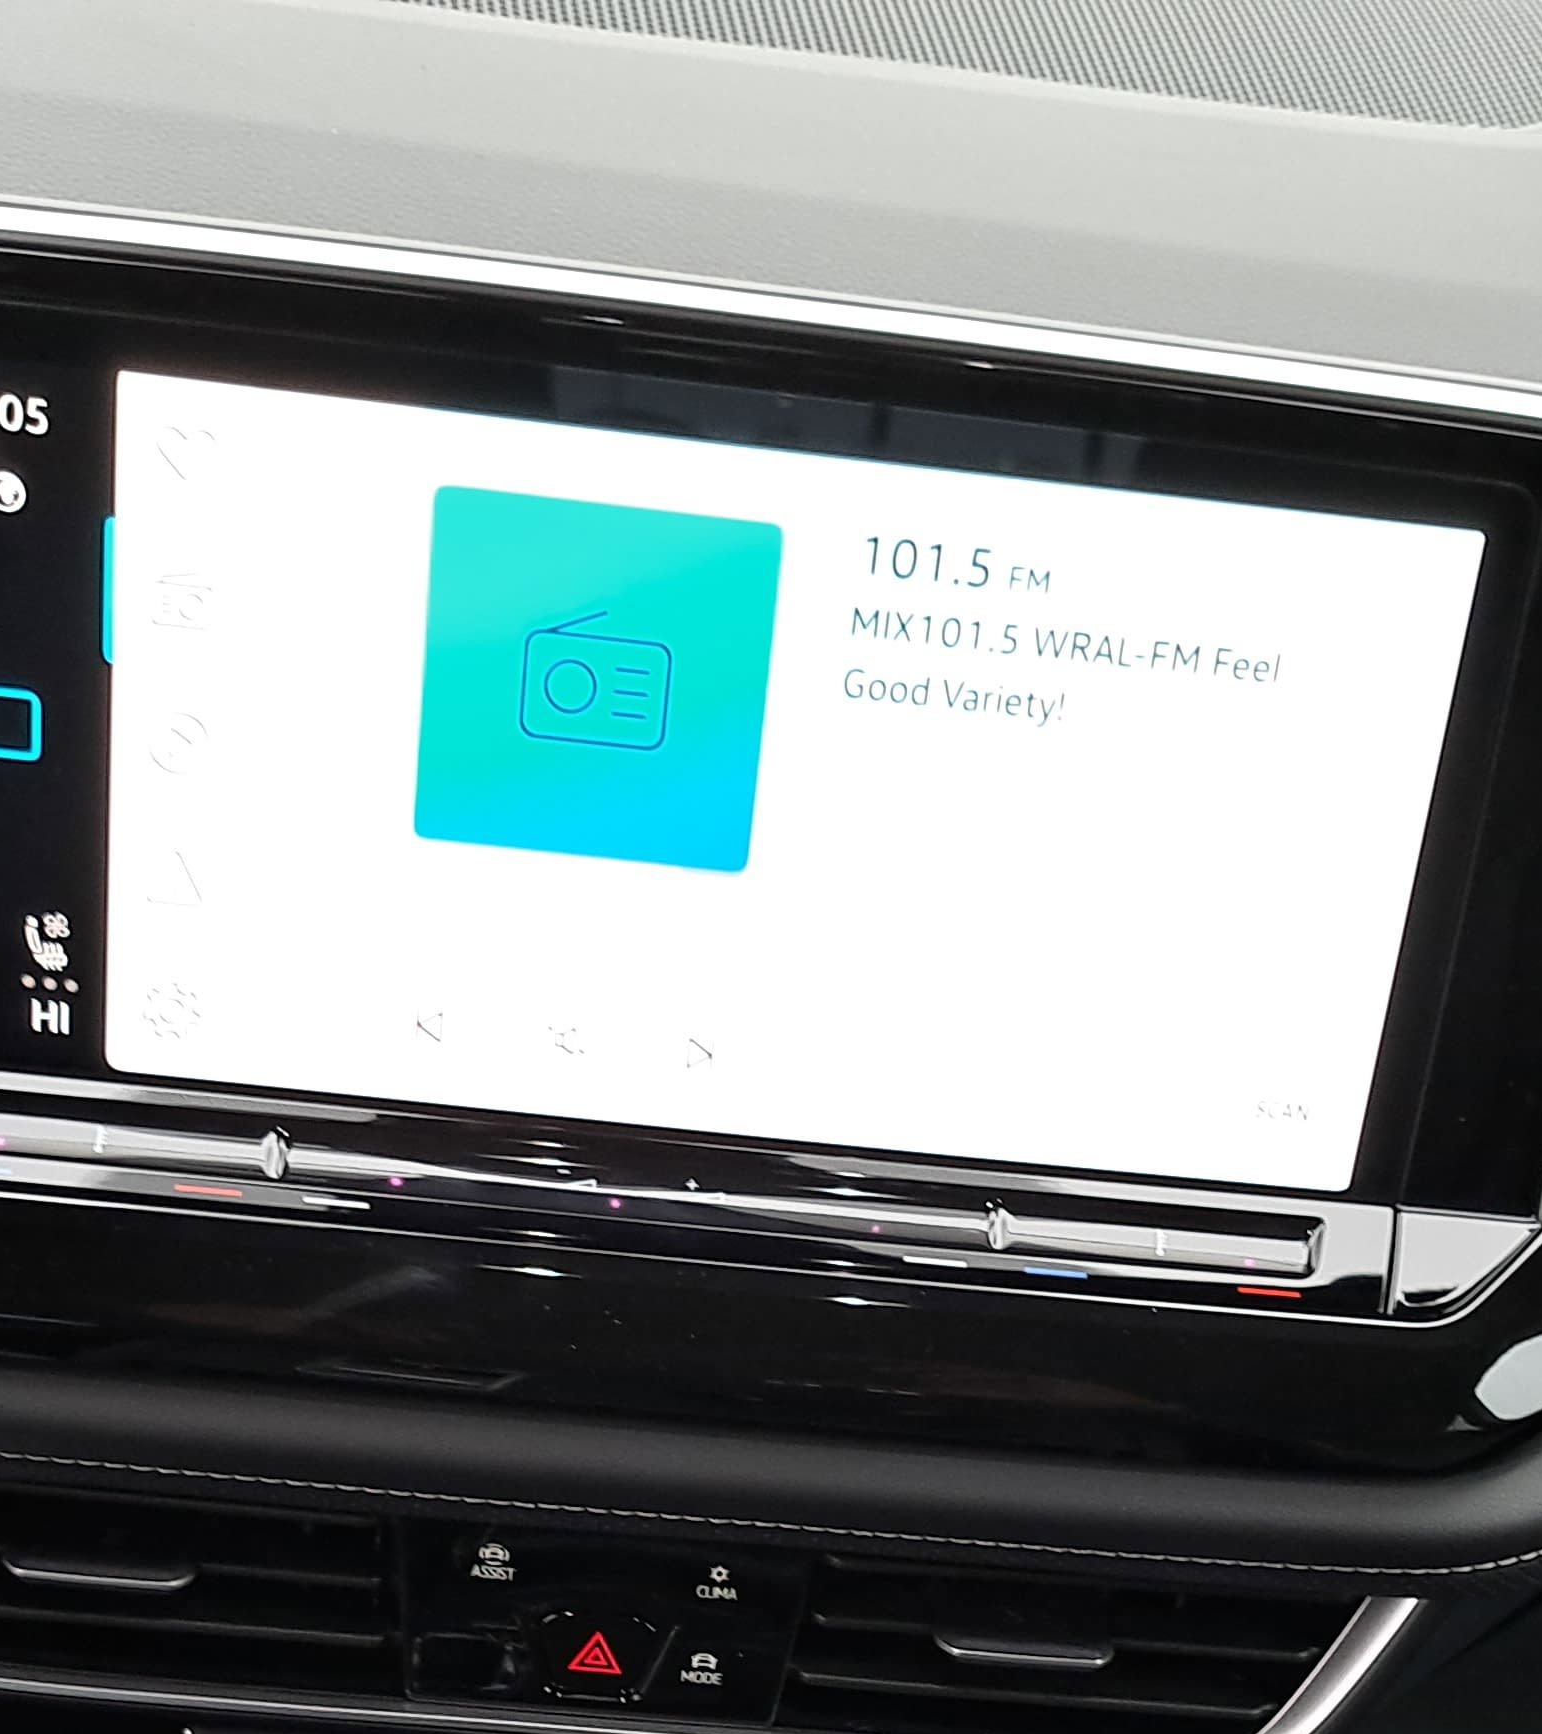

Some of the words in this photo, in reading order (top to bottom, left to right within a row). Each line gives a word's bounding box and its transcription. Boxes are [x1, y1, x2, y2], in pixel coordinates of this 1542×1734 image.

[866, 535, 993, 588] 101.5
[1008, 565, 1052, 594] FM
[850, 606, 1020, 655] MIX101.5
[1033, 627, 1201, 674] WRAL-FM
[1212, 647, 1282, 684] Feel
[843, 668, 930, 707] Good
[944, 677, 1066, 728] Variety!
[29, 997, 71, 1036] HI
[695, 1584, 739, 1601] CLIMA
[680, 1670, 724, 1686] MODE
